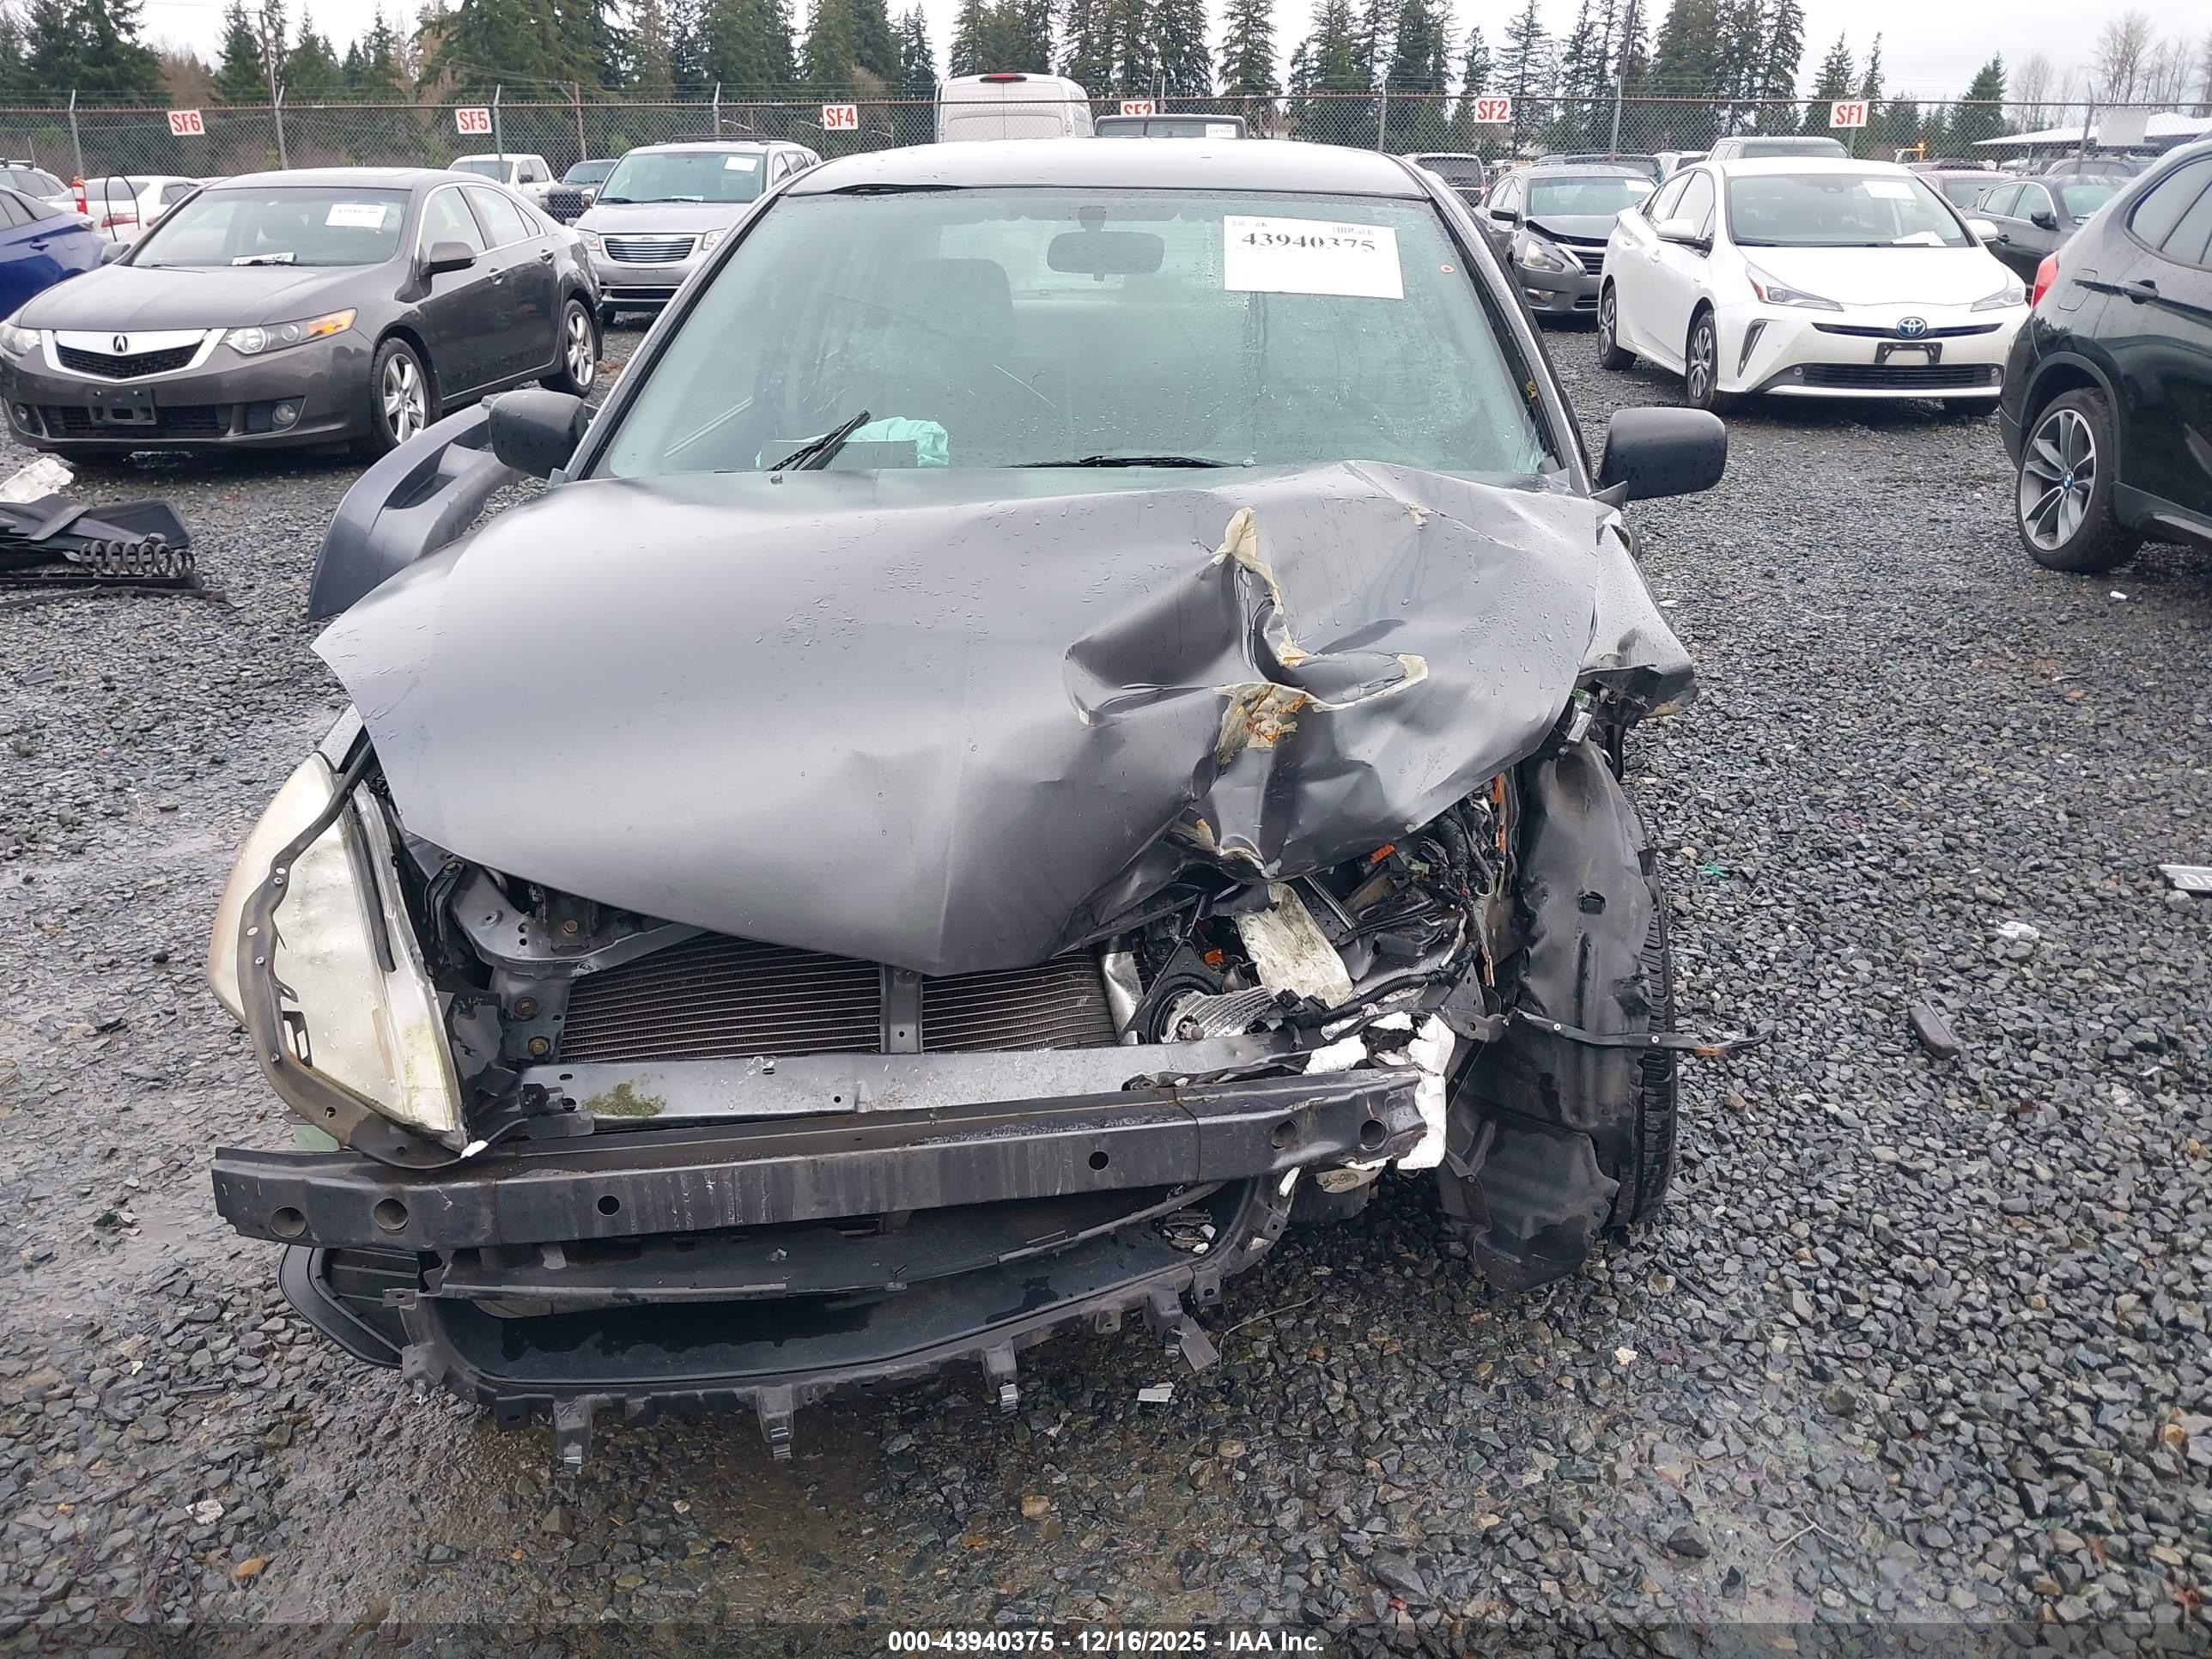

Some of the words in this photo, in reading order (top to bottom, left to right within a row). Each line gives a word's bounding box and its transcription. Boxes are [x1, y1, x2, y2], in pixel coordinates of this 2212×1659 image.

[826, 107, 855, 127] SF4
[1477, 100, 1508, 120] SF2
[1835, 104, 1863, 125] SF1
[172, 113, 200, 132] SF6
[459, 112, 488, 131] SF5
[1242, 233, 1376, 252] 43940375
